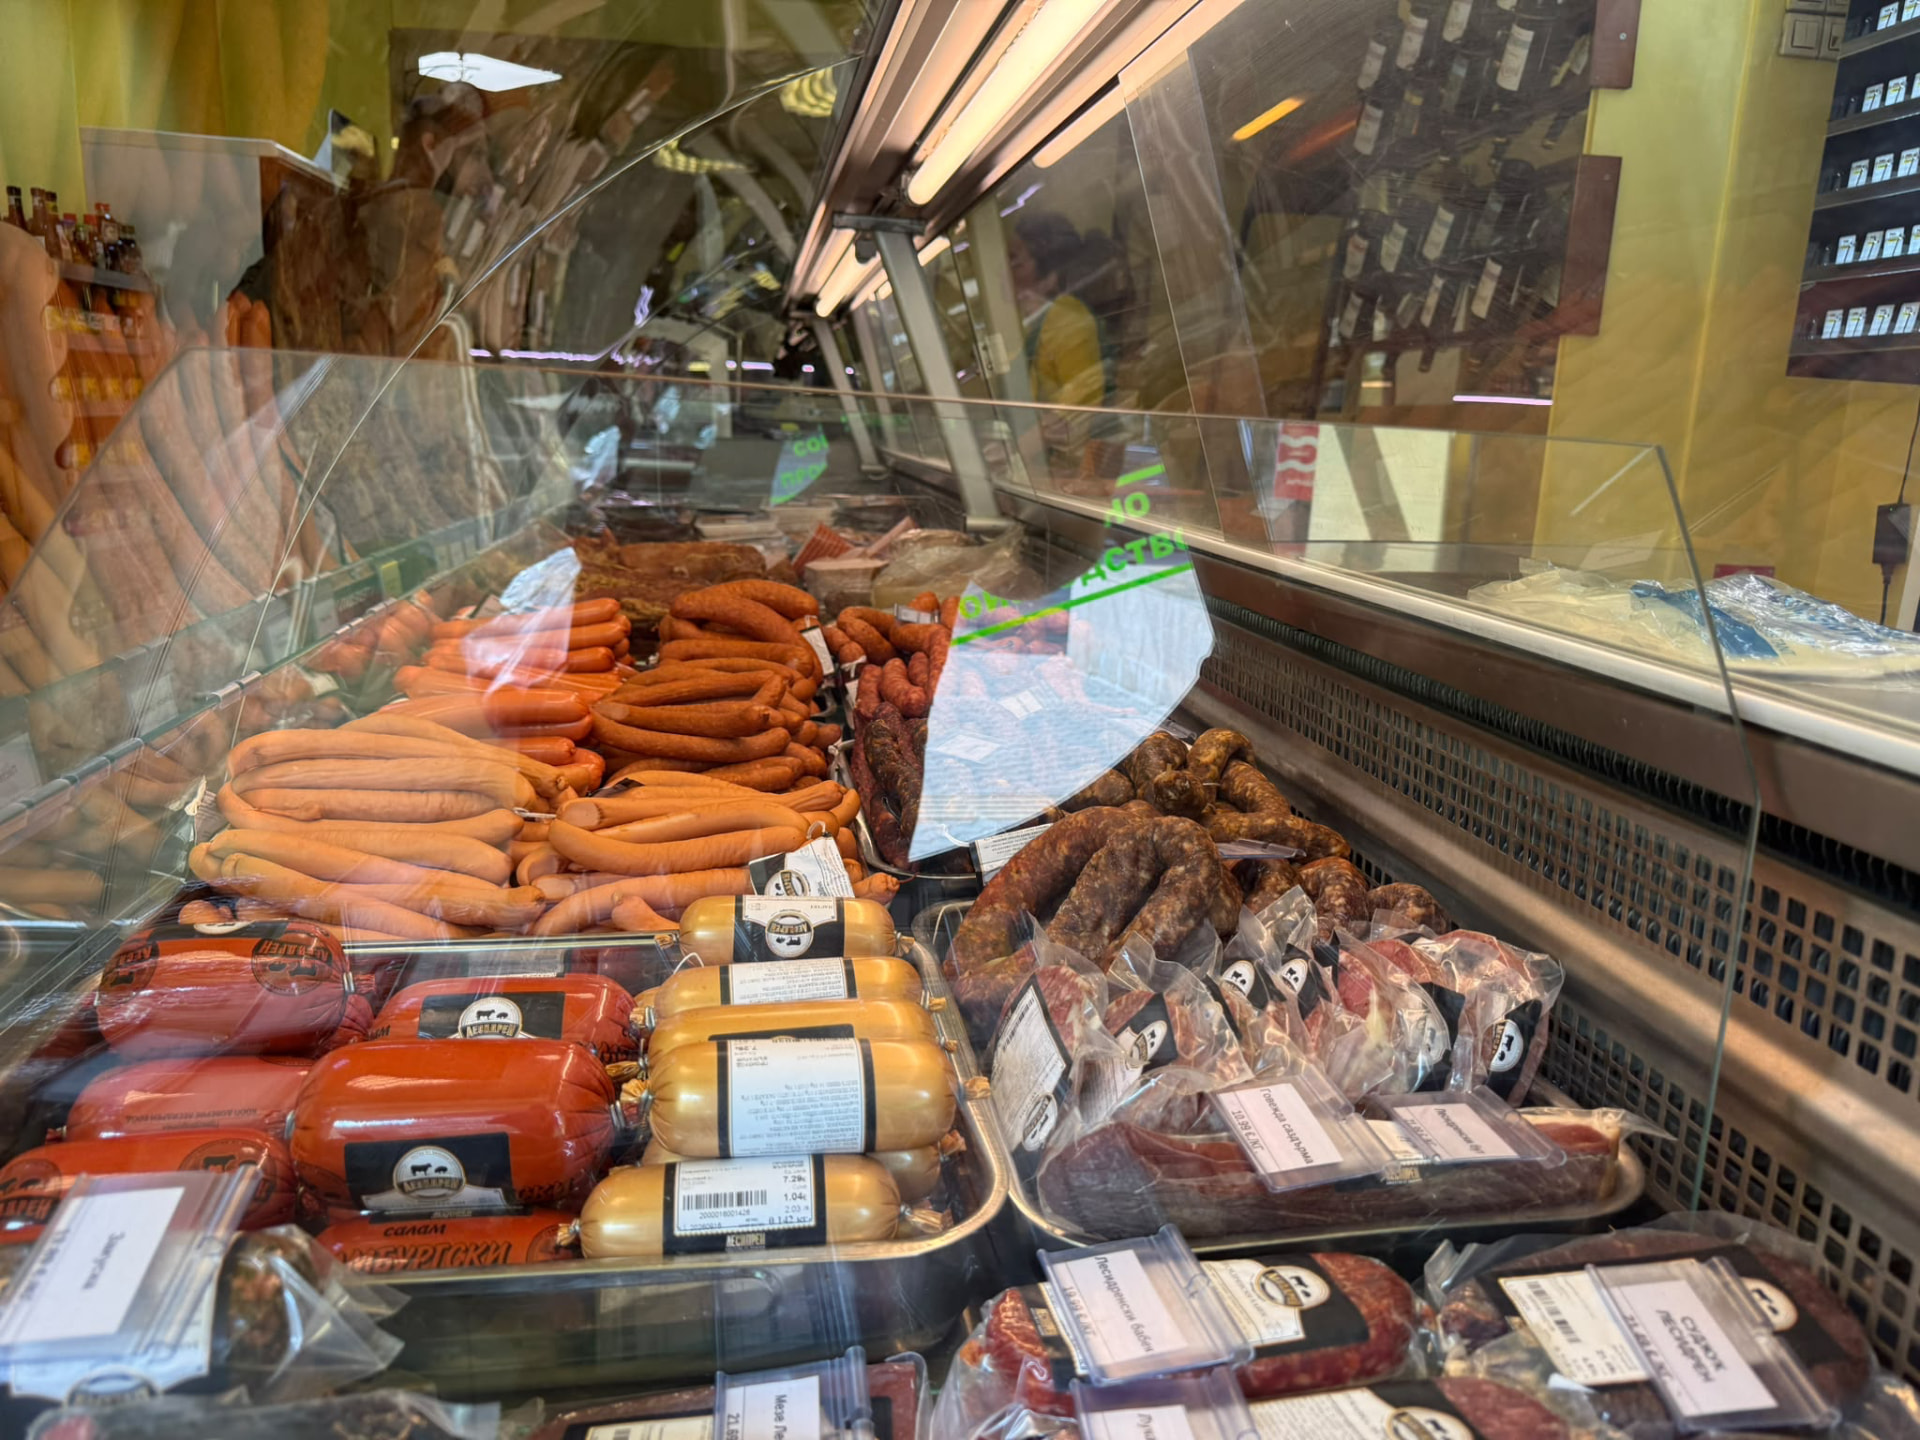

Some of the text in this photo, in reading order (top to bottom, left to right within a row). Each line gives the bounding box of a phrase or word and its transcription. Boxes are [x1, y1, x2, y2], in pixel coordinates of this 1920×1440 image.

[780, 464, 827, 488] ПРО
[1260, 1088, 1286, 1122] Говежда
[384, 1224, 446, 1238] салам
[1095, 1256, 1137, 1321] Лесидренски
[774, 1394, 787, 1422] Мезе
